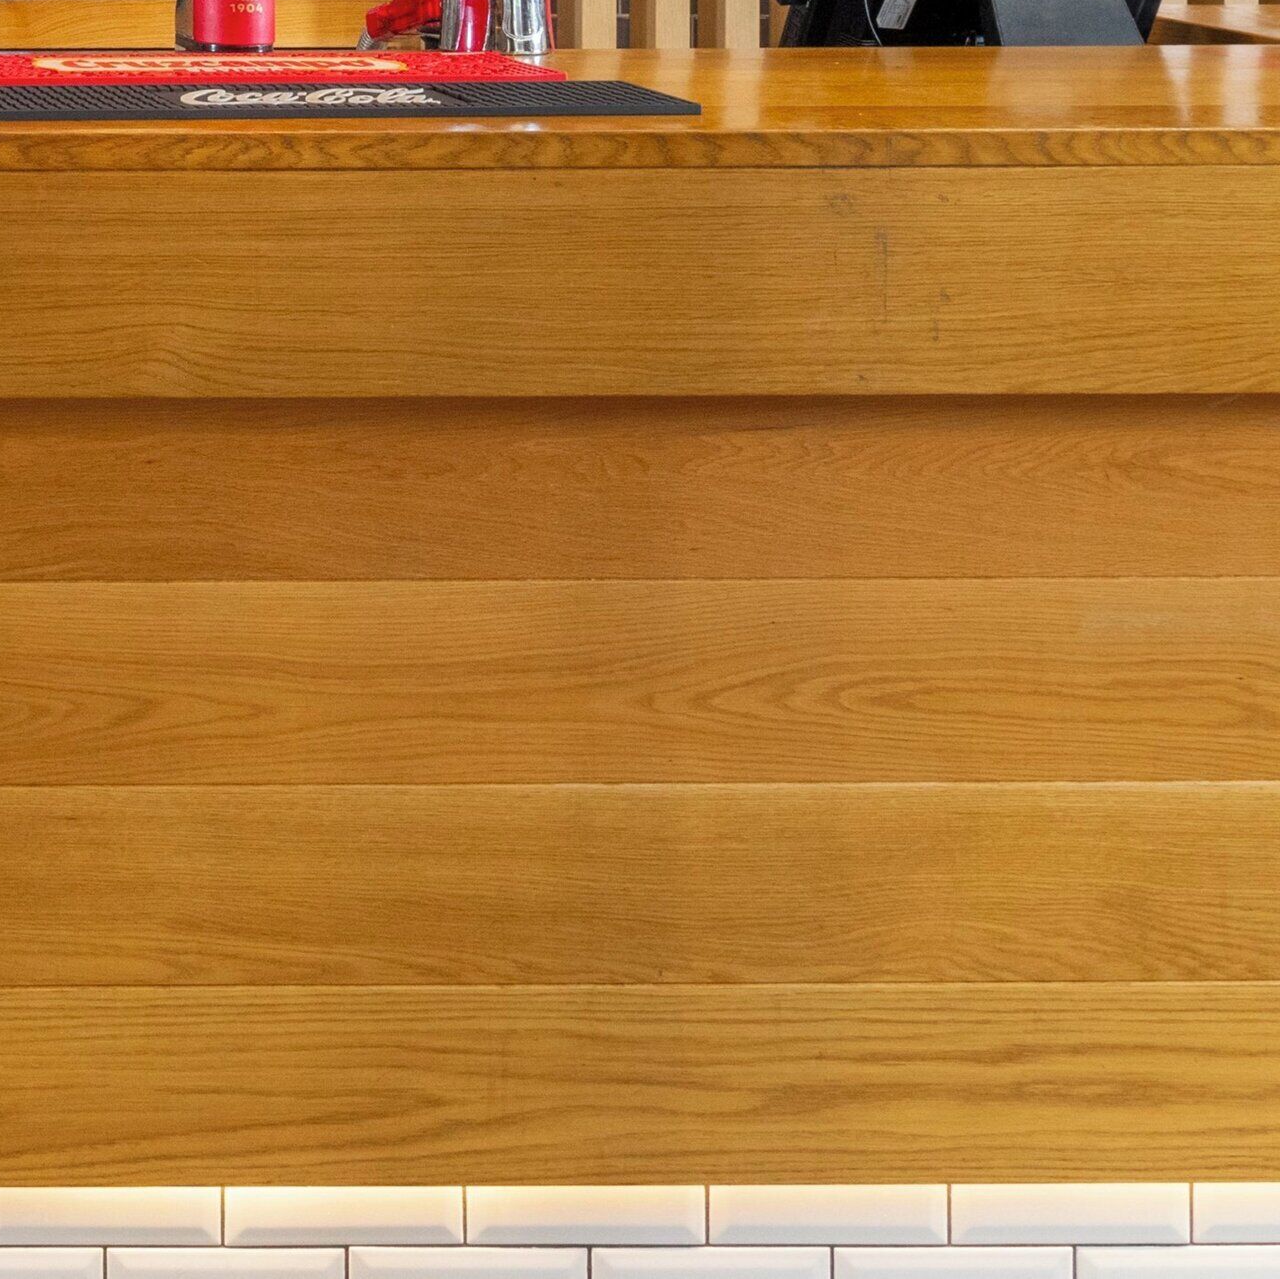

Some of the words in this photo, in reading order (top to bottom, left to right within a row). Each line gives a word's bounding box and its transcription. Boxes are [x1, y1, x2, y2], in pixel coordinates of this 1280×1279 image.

[230, 3, 263, 13] 1904
[60, 58, 371, 71] Cruzcampo
[180, 88, 440, 106] Coca-Cola
